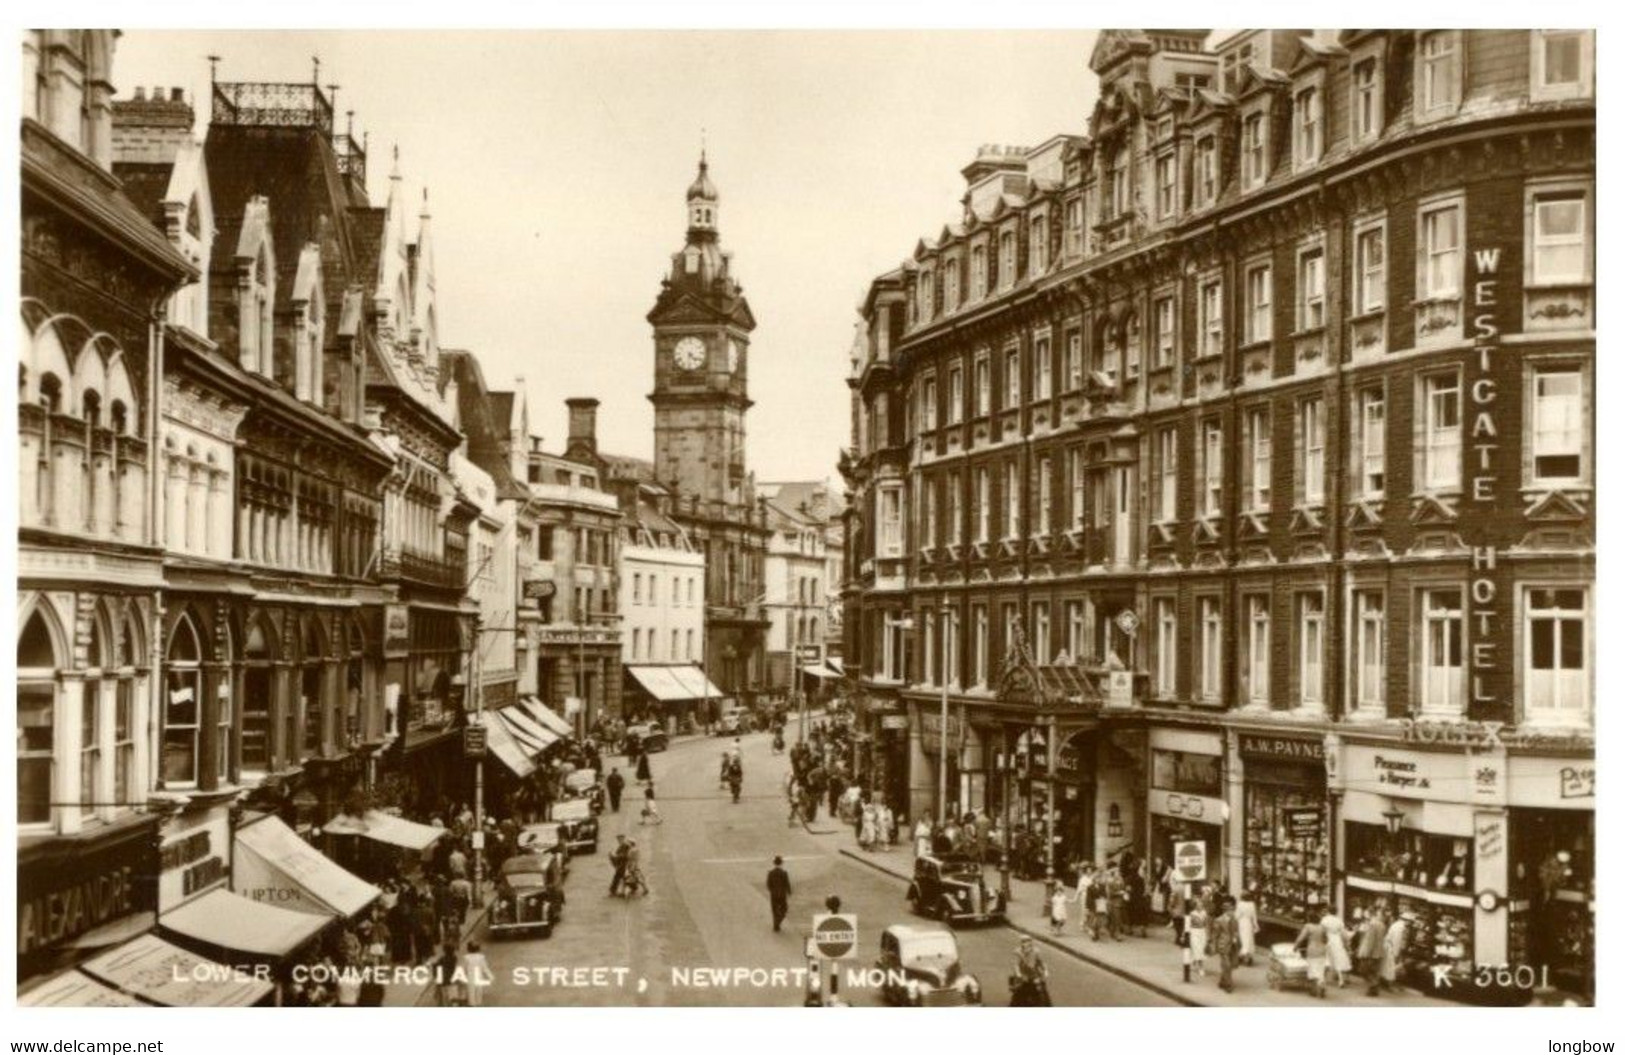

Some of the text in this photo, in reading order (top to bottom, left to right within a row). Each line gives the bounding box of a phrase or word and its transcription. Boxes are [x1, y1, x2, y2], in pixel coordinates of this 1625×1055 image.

[1472, 248, 1501, 701] WESTGATE HOTEL
[1401, 719, 1505, 746] ROLEX
[18, 866, 132, 954] ALEXANDRE
